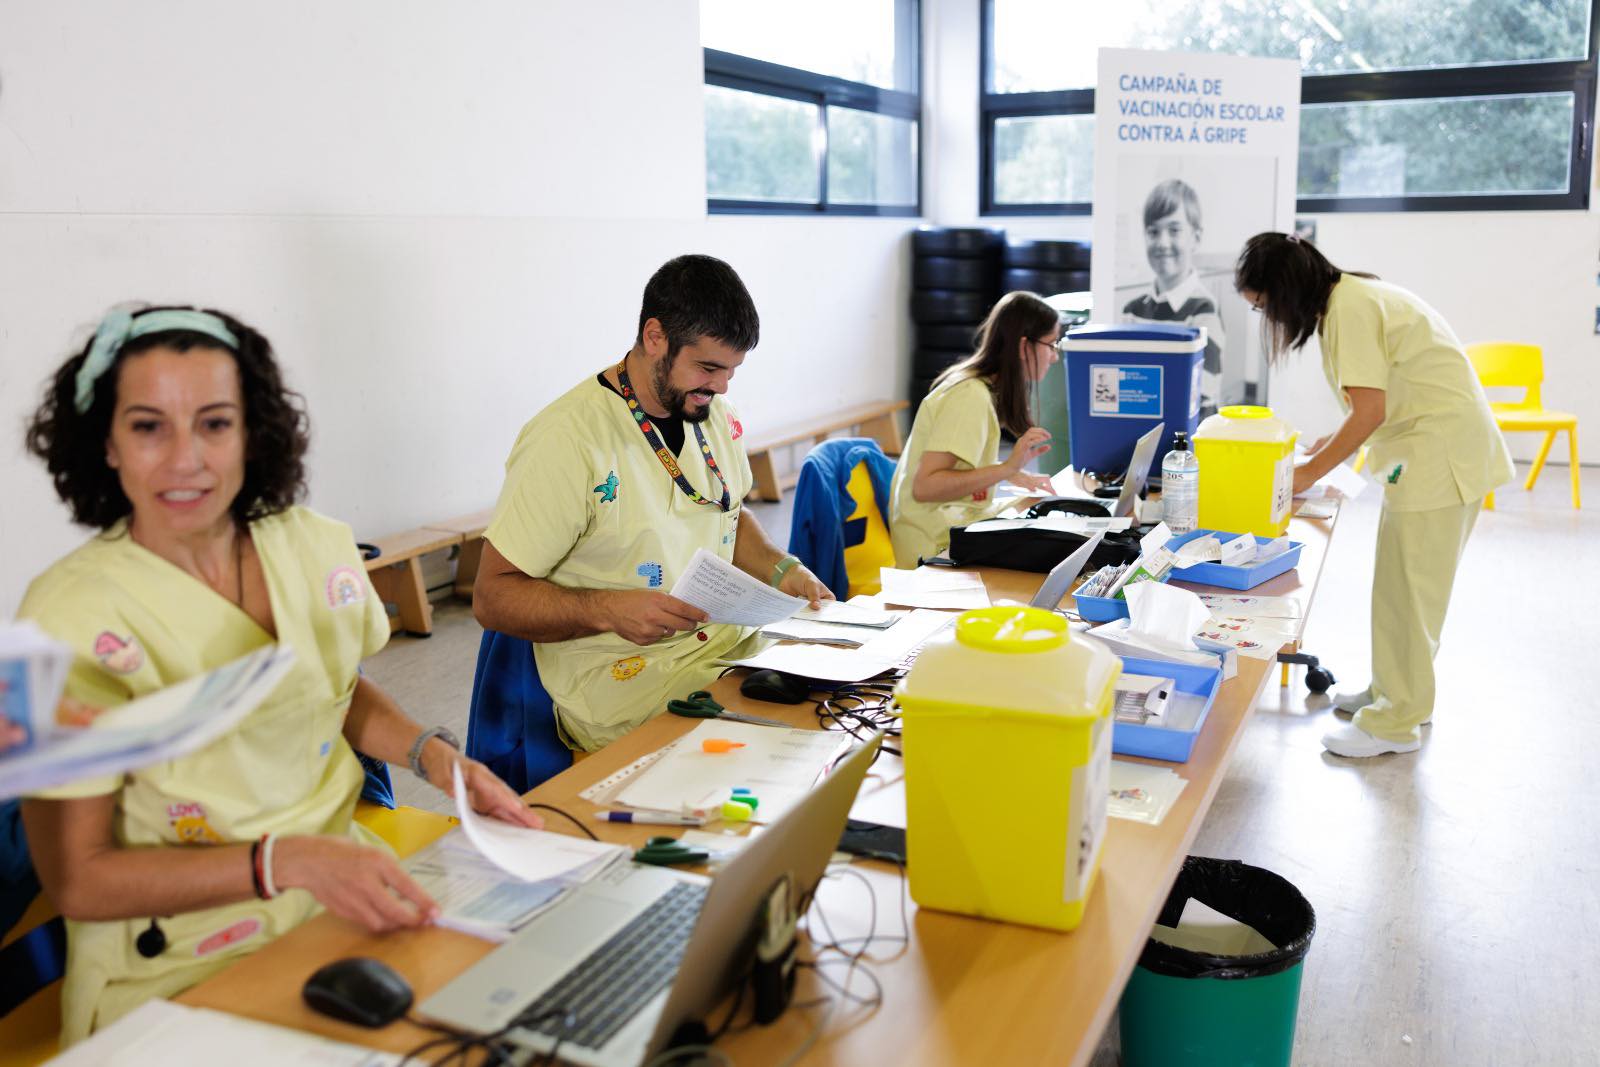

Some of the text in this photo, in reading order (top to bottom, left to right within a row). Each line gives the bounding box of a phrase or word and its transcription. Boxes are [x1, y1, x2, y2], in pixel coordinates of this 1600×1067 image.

[1119, 73, 1222, 96] CAMPAÑA DE
[1118, 98, 1285, 121] VACINACIÓN ESCOLAR
[1118, 121, 1247, 144] CONTRA Á GRIPE
